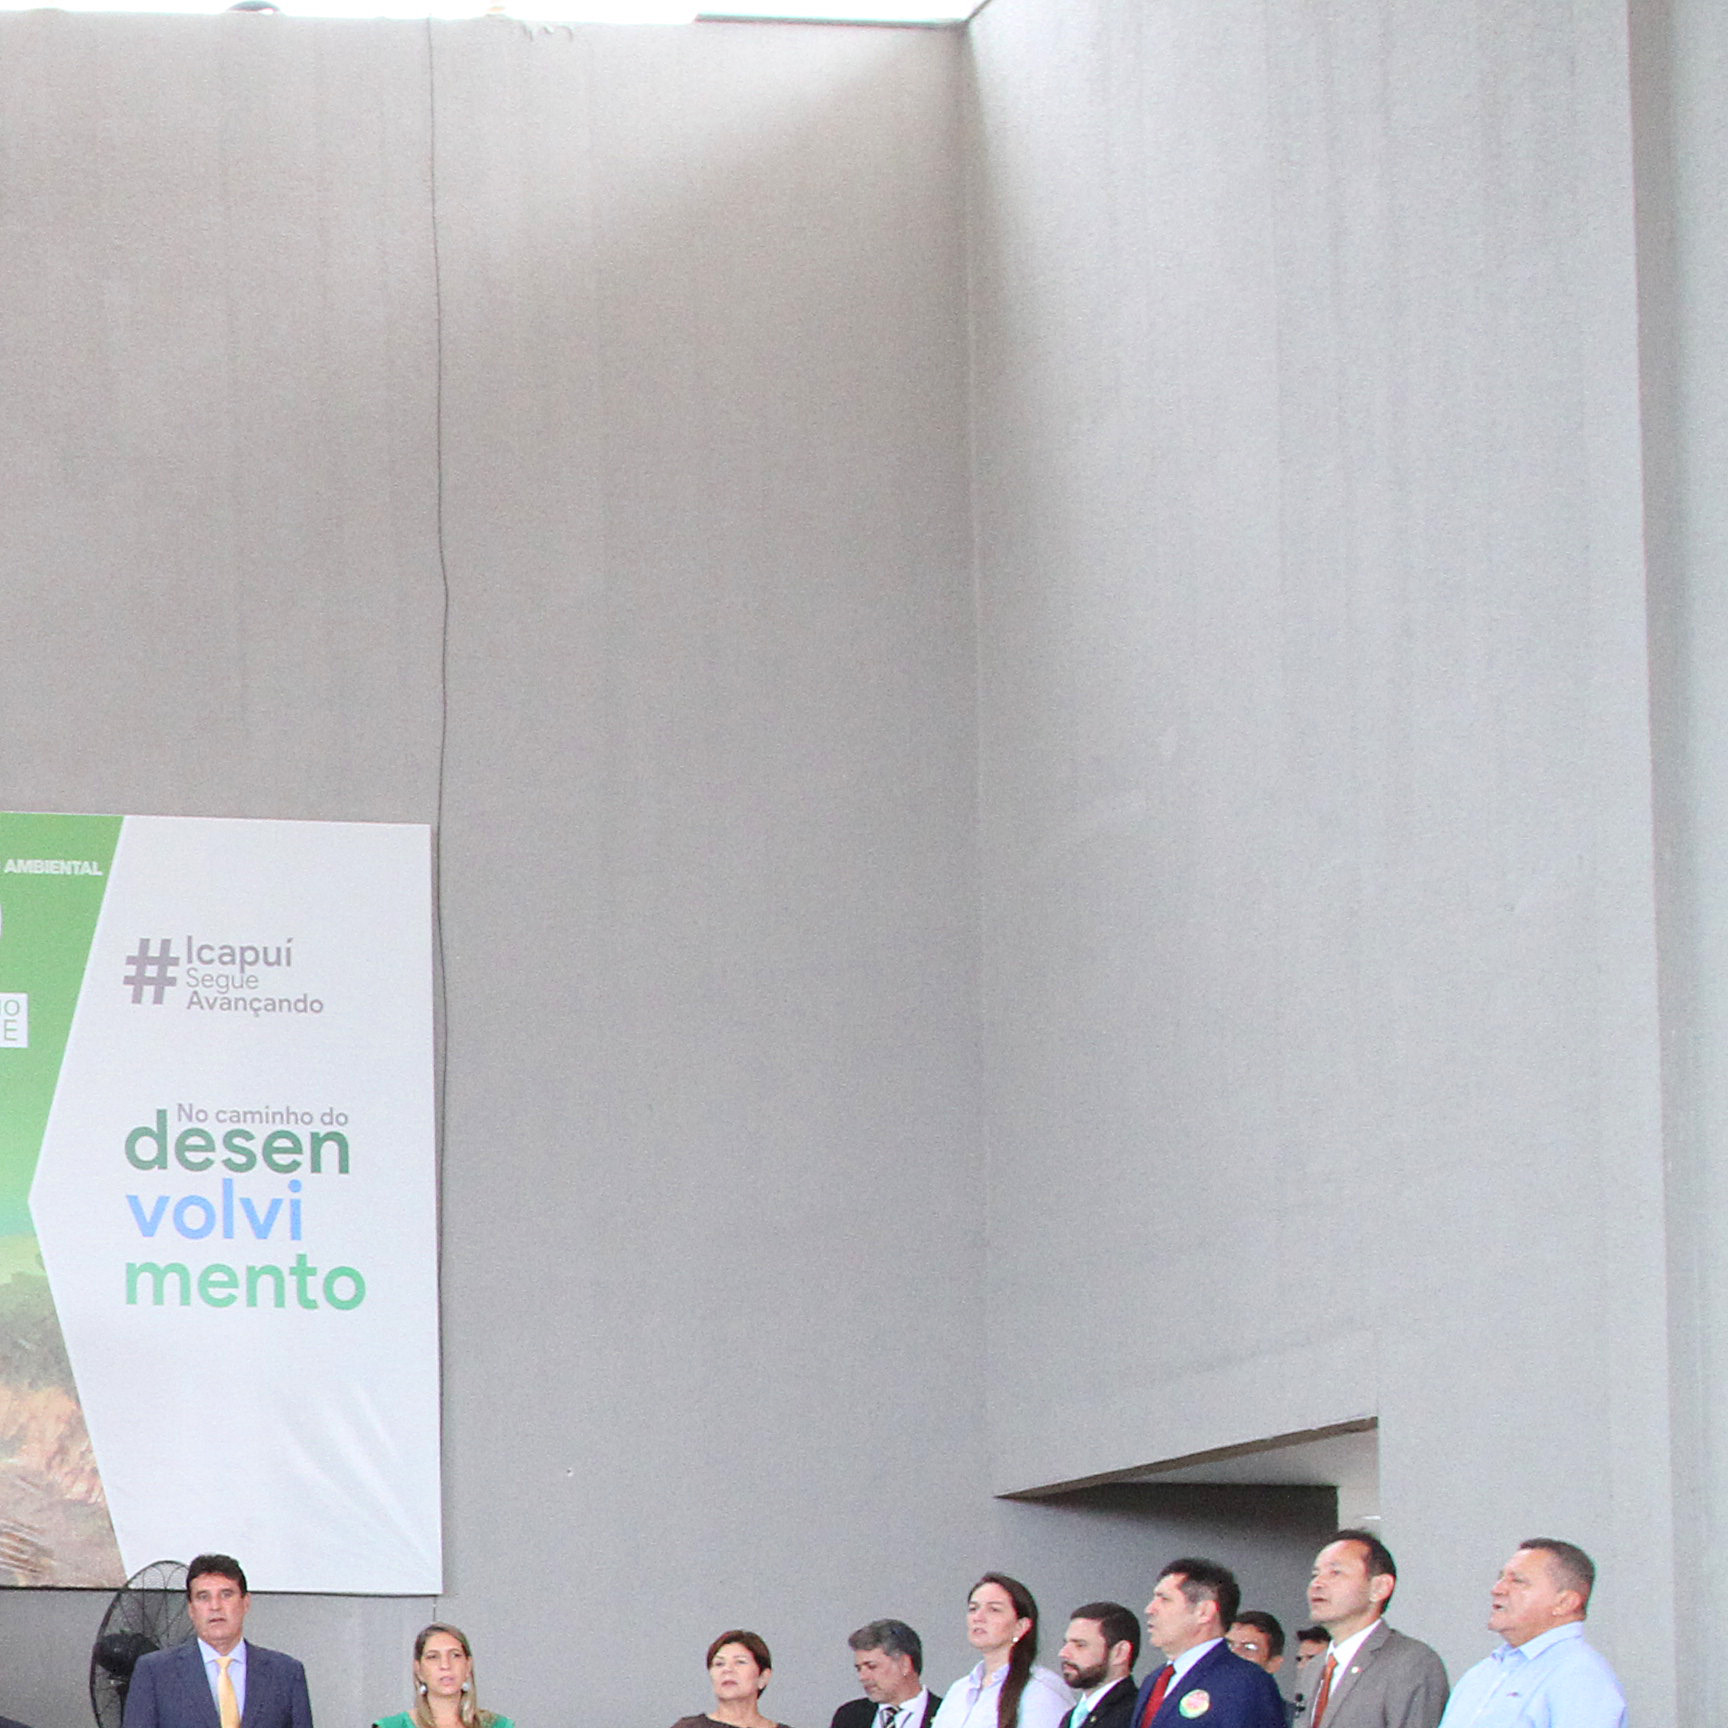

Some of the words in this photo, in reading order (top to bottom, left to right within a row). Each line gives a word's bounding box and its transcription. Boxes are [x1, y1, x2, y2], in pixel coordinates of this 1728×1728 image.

[4, 858, 104, 877] AMBIENTAL
[186, 967, 260, 994] Segue
[186, 990, 325, 1017] Avançando
[177, 1103, 209, 1124] No
[215, 1106, 314, 1126] caminho
[320, 1107, 349, 1126] do
[124, 1109, 350, 1174] desen
[125, 1178, 303, 1241] volvi
[125, 1253, 366, 1311] mento
